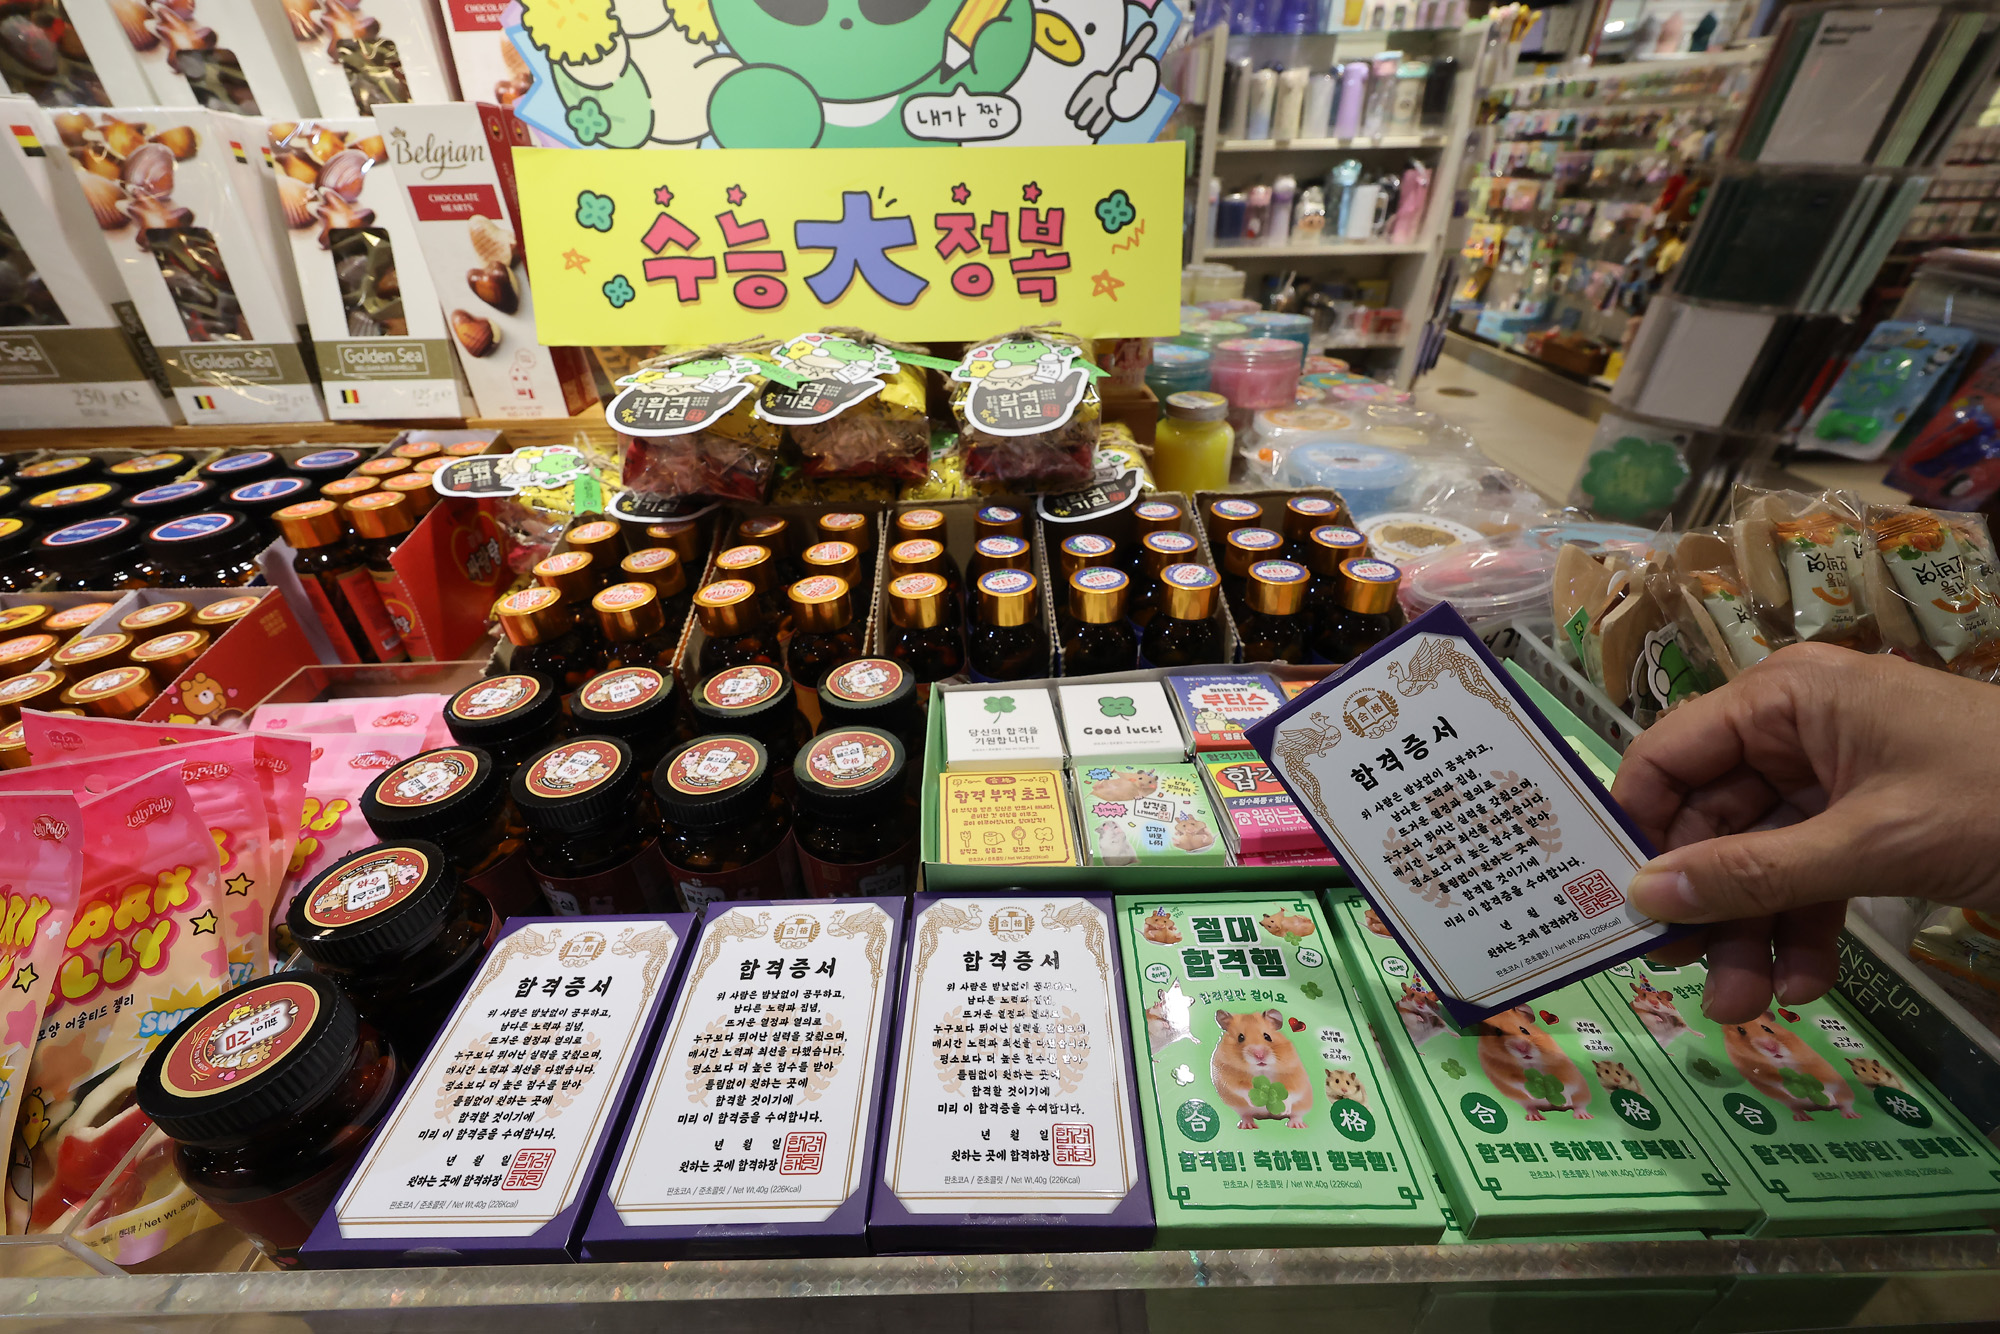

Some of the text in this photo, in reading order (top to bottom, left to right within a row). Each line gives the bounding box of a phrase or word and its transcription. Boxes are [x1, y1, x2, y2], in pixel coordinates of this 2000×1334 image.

[917, 103, 1003, 128] 내가 짱
[392, 133, 485, 181] Belgian
[428, 192, 480, 203] CHOCOLATE
[441, 203, 474, 213] HEARTS
[190, 352, 273, 369] Golden Sea
[344, 347, 423, 364] Golden Sea
[1202, 693, 1269, 706] 부터스
[969, 727, 1038, 736] 당신의 합격을
[1083, 725, 1163, 735] Good luck!
[975, 736, 1035, 745] 기원합니다!
[1206, 752, 1256, 761] 합격기원
[1350, 715, 1459, 791] 합격증서
[350, 754, 399, 769] LollyPolly
[181, 763, 232, 782] lyPolly
[954, 787, 1050, 803] 합격 부적 초코
[1239, 796, 1267, 805] 점수폭등
[126, 796, 173, 829] LollyPolly
[1252, 807, 1306, 826] 원하는곳
[1192, 917, 1258, 943] 절대
[740, 958, 836, 980] 합격증서
[963, 950, 1061, 972] 합격증서
[1182, 948, 1287, 977] 합격햄
[515, 976, 612, 999] 합격증서
[717, 990, 844, 1000] 위 사람은 밤낮없이 공부하고,
[1837, 965, 1886, 1014] SKET
[1199, 989, 1288, 1005] 합격길만 걸어요
[65, 1007, 108, 1030] 어솔티드
[113, 994, 134, 1013] 젤리
[735, 1003, 820, 1013] 남다른 노력과 집념,
[725, 1017, 821, 1027] 뜨거운 열정과 열의로
[694, 1031, 847, 1043] 누구보다 뛰어난 실력을 갖췄으며,
[689, 1046, 844, 1058] 매시간 노력과 최선을 다했습니다.
[693, 1062, 833, 1074] 평소보다 더 높은 점수를 받아
[706, 1078, 808, 1090] 틀림없이 원하는 곳에
[716, 1094, 793, 1106] 합격할 것이기에
[1886, 1095, 1920, 1119] 格
[678, 1111, 822, 1124] 미리 이 합격증을 수여합니다.
[1469, 1104, 1497, 1125] 合
[1619, 1099, 1651, 1121] 格
[1736, 1102, 1765, 1126] 合
[1186, 1110, 1211, 1132] 合
[1339, 1109, 1368, 1132] 格
[715, 1138, 783, 1150] 년 월 일
[1474, 1139, 1697, 1164] 합격햄! 축하햄! 행복햄!
[1751, 1137, 1978, 1166] 합격햄! 축하햄! 행복햄!
[679, 1160, 710, 1172] 원하는
[713, 1160, 735, 1172] 곳에
[1178, 1150, 1398, 1172] 합격햄! 축하햄! 행복햄!
[1291, 1180, 1302, 1189] Net
[144, 1216, 161, 1229] Net
